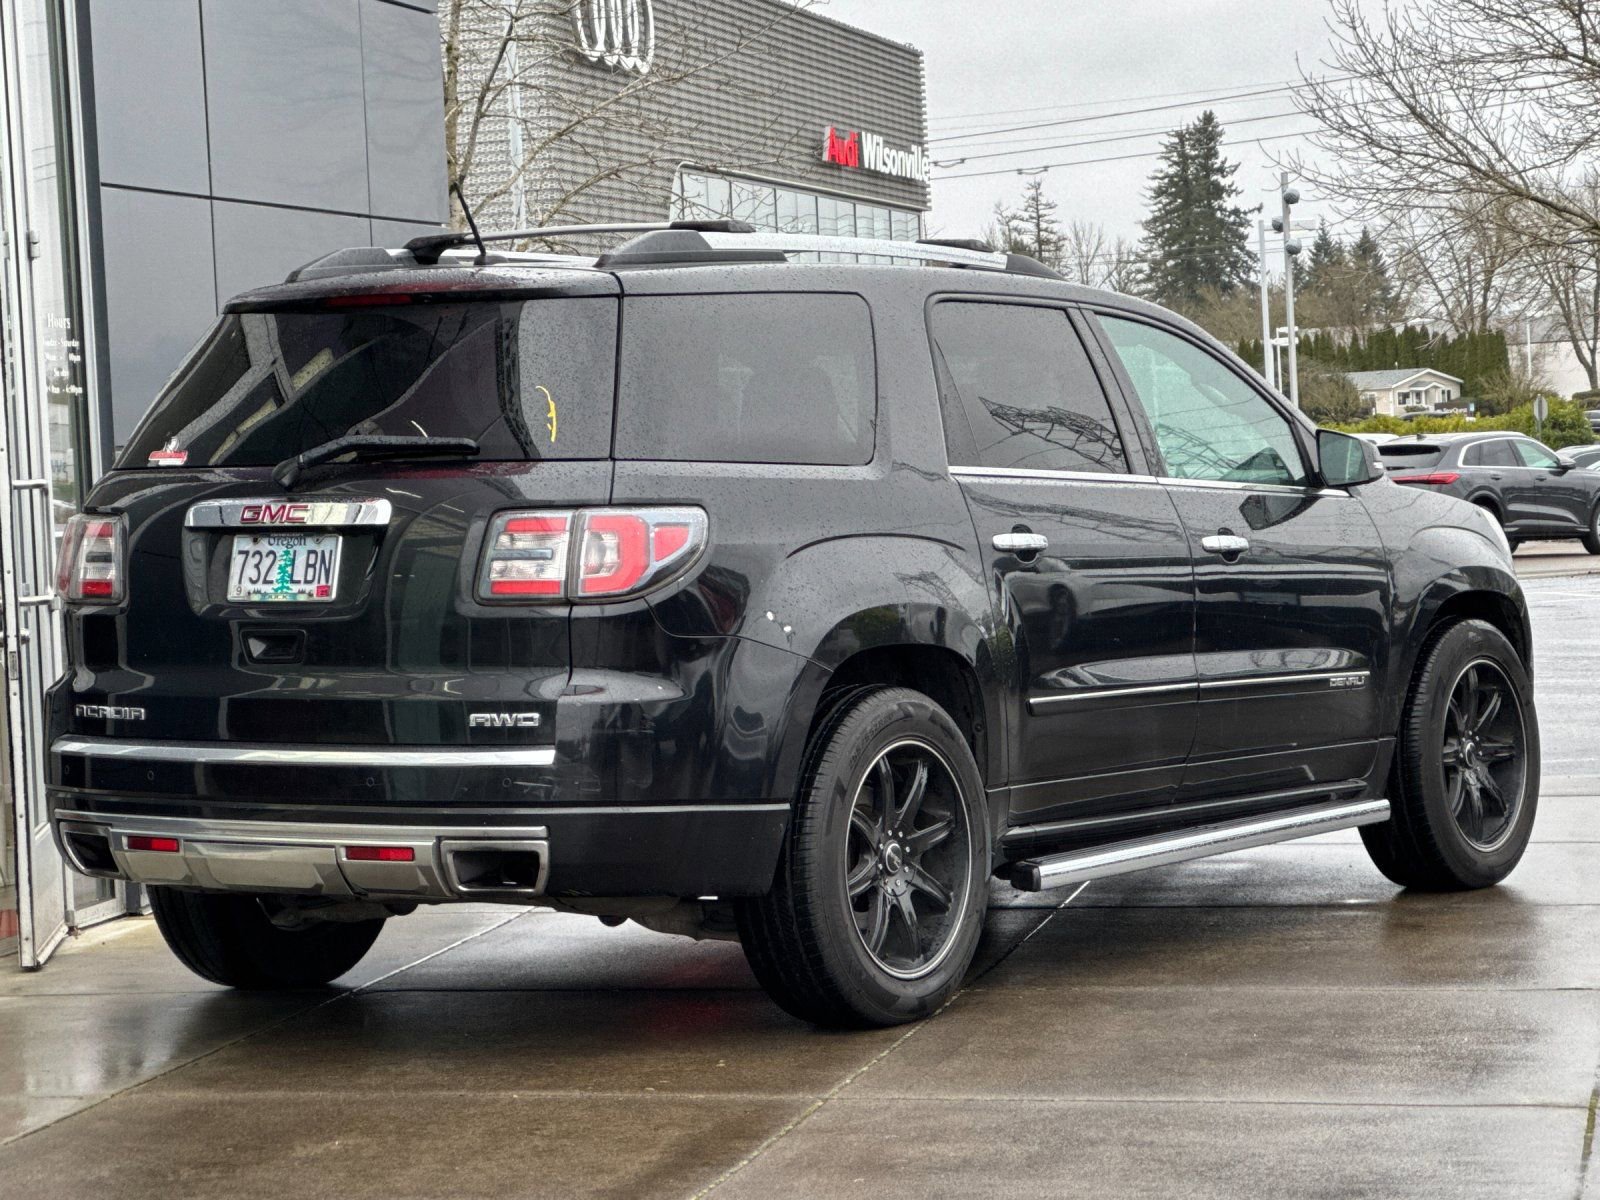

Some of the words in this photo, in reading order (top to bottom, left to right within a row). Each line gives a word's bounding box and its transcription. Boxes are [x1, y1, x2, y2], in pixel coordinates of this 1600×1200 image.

[824, 126, 859, 168] Audi
[861, 131, 930, 182] Wilsonville
[47, 312, 71, 329] Hours
[240, 504, 309, 524] GMC
[267, 535, 307, 549] Oregon
[238, 550, 277, 585] 732
[290, 549, 333, 585] LBN
[1330, 676, 1365, 687] DENALI
[76, 704, 145, 720] ACADIA
[469, 712, 540, 727] AWD
